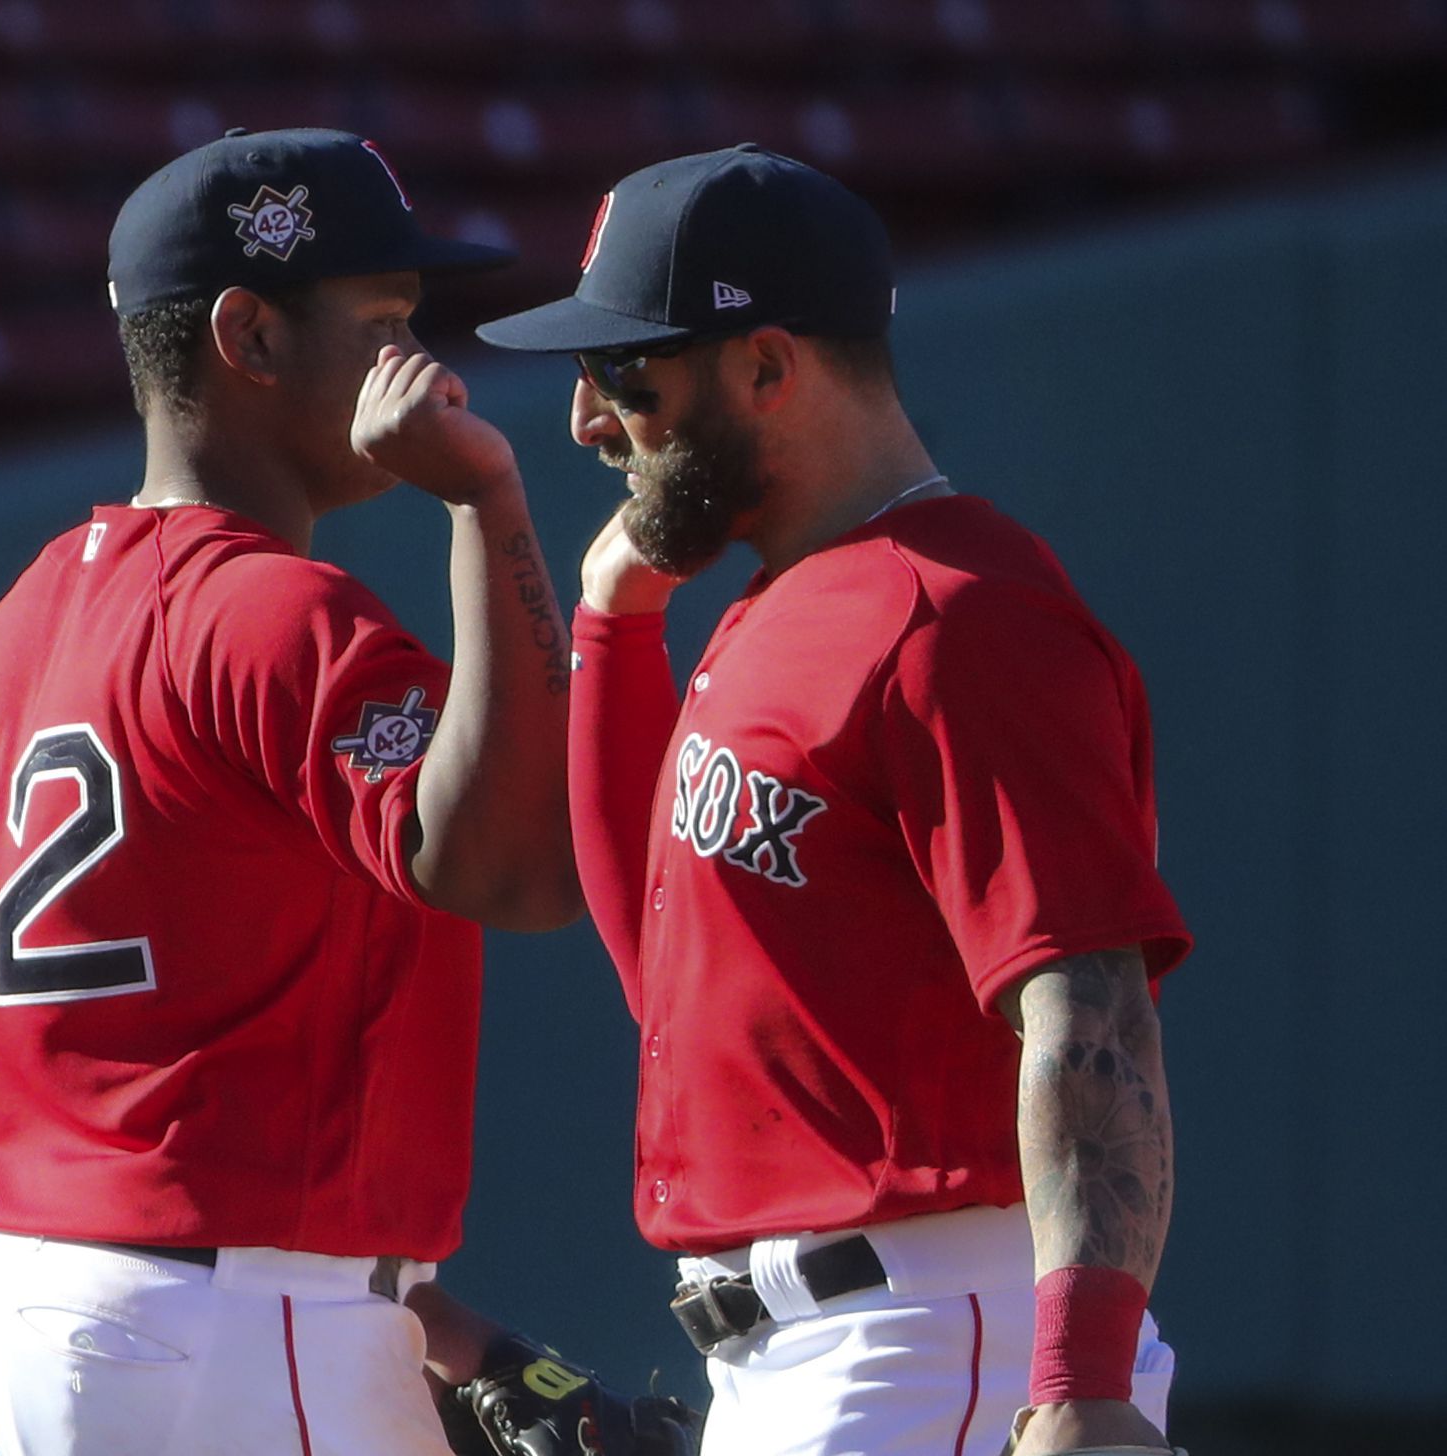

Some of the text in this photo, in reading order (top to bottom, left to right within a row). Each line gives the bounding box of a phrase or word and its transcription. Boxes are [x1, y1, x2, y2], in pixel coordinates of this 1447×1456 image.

[258, 209, 292, 235] 42
[374, 719, 416, 754] 42
[672, 732, 828, 888] SOX
